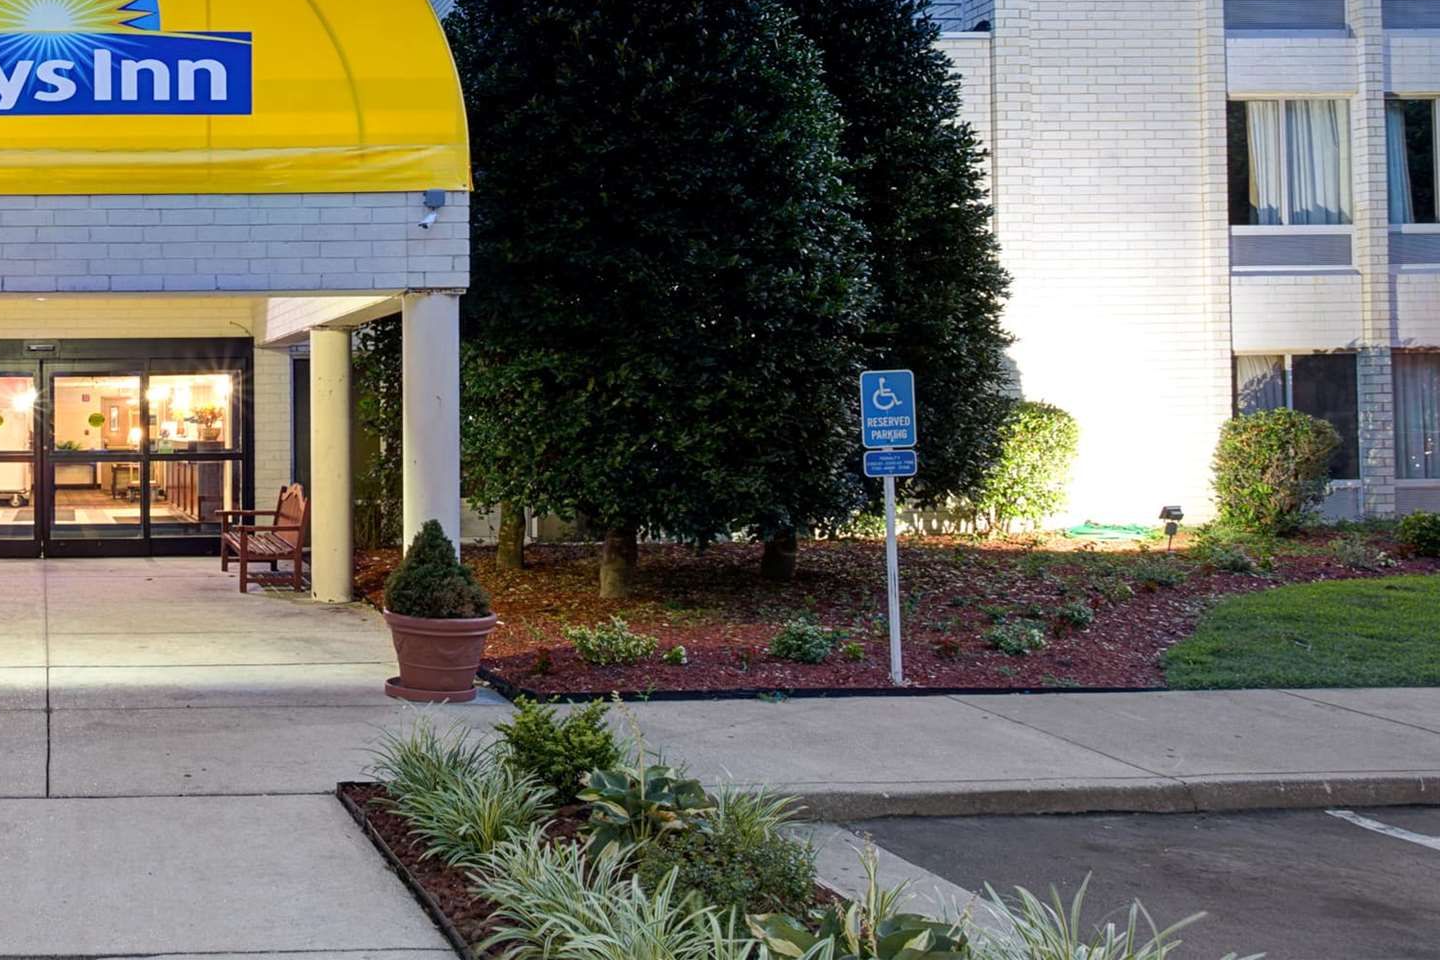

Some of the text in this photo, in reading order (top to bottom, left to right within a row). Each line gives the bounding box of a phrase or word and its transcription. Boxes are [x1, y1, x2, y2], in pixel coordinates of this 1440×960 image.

[94, 49, 227, 100] Inn
[866, 416, 911, 427] RESERVED
[871, 429, 908, 440] PARKING
